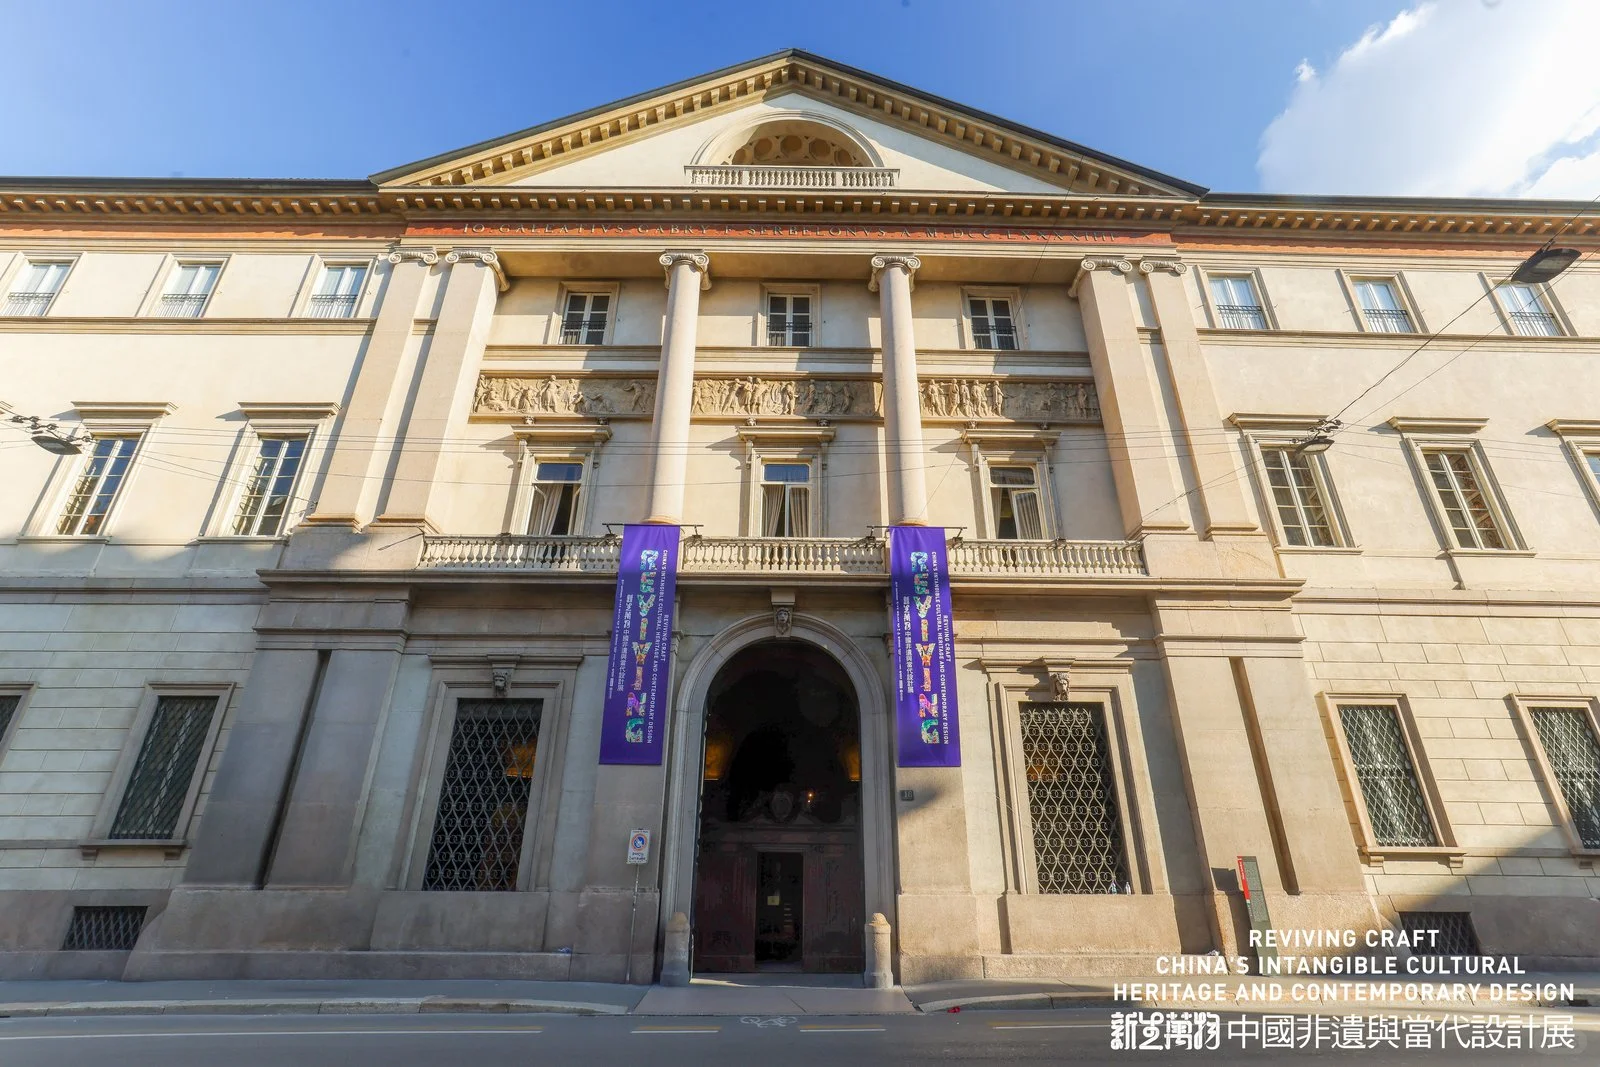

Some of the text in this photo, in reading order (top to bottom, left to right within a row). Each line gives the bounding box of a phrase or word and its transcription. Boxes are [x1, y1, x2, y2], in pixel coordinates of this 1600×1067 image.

[661, 549, 669, 570] CHINA'S
[658, 570, 666, 604] INTANGIBLE
[656, 603, 664, 630] CULTURAL
[933, 572, 941, 604] INTANGIBLE
[940, 673, 948, 721] CONTEMPORARY
[649, 673, 657, 720] CONTEMPORARY
